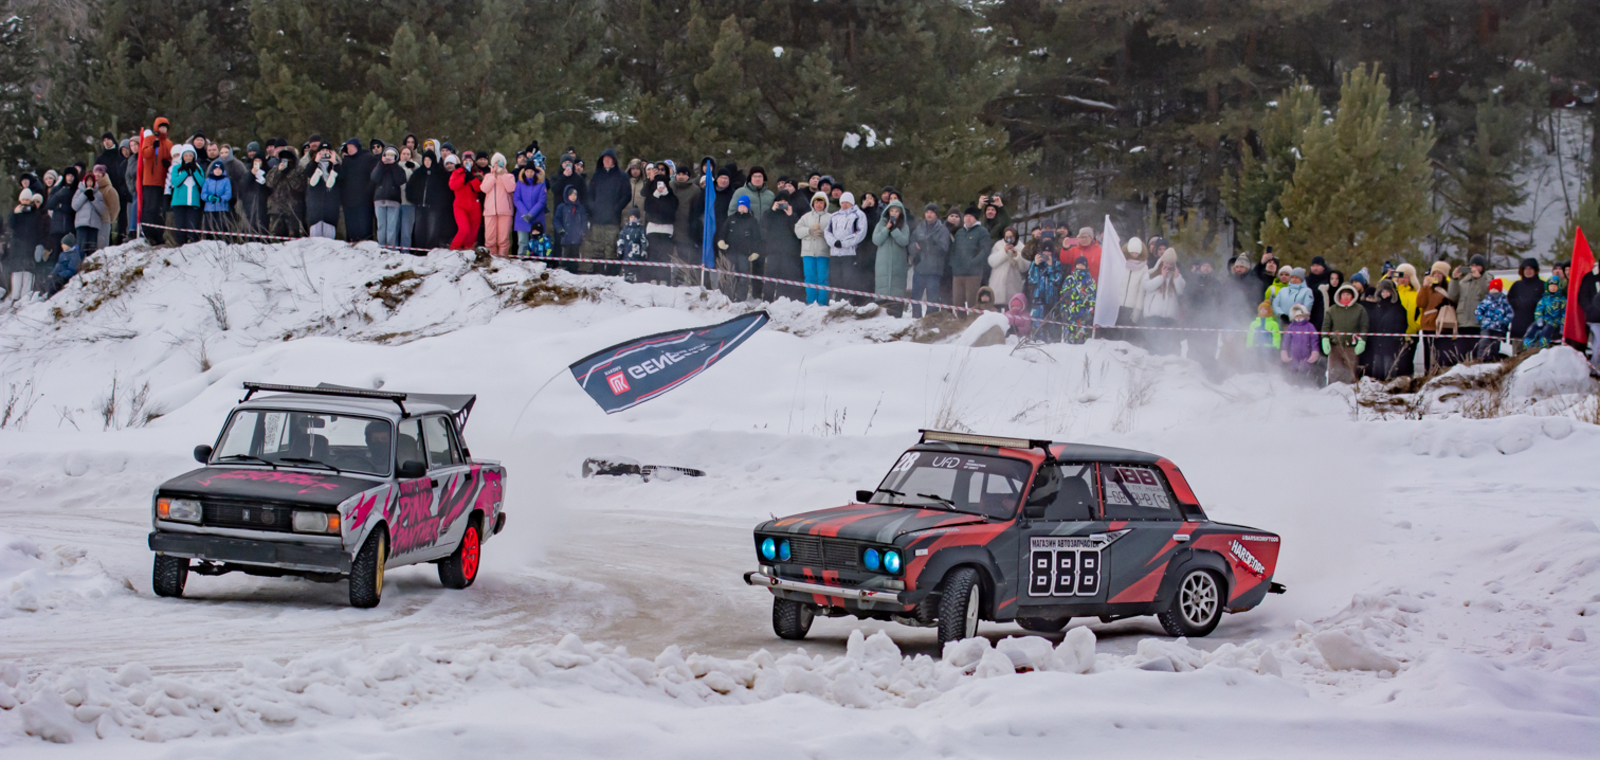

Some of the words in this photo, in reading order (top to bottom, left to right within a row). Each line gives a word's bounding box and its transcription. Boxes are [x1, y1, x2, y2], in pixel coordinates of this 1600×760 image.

[892, 452, 921, 472] 28
[1032, 539, 1056, 548] МАГАЗИН
[1028, 550, 1101, 596] 888
